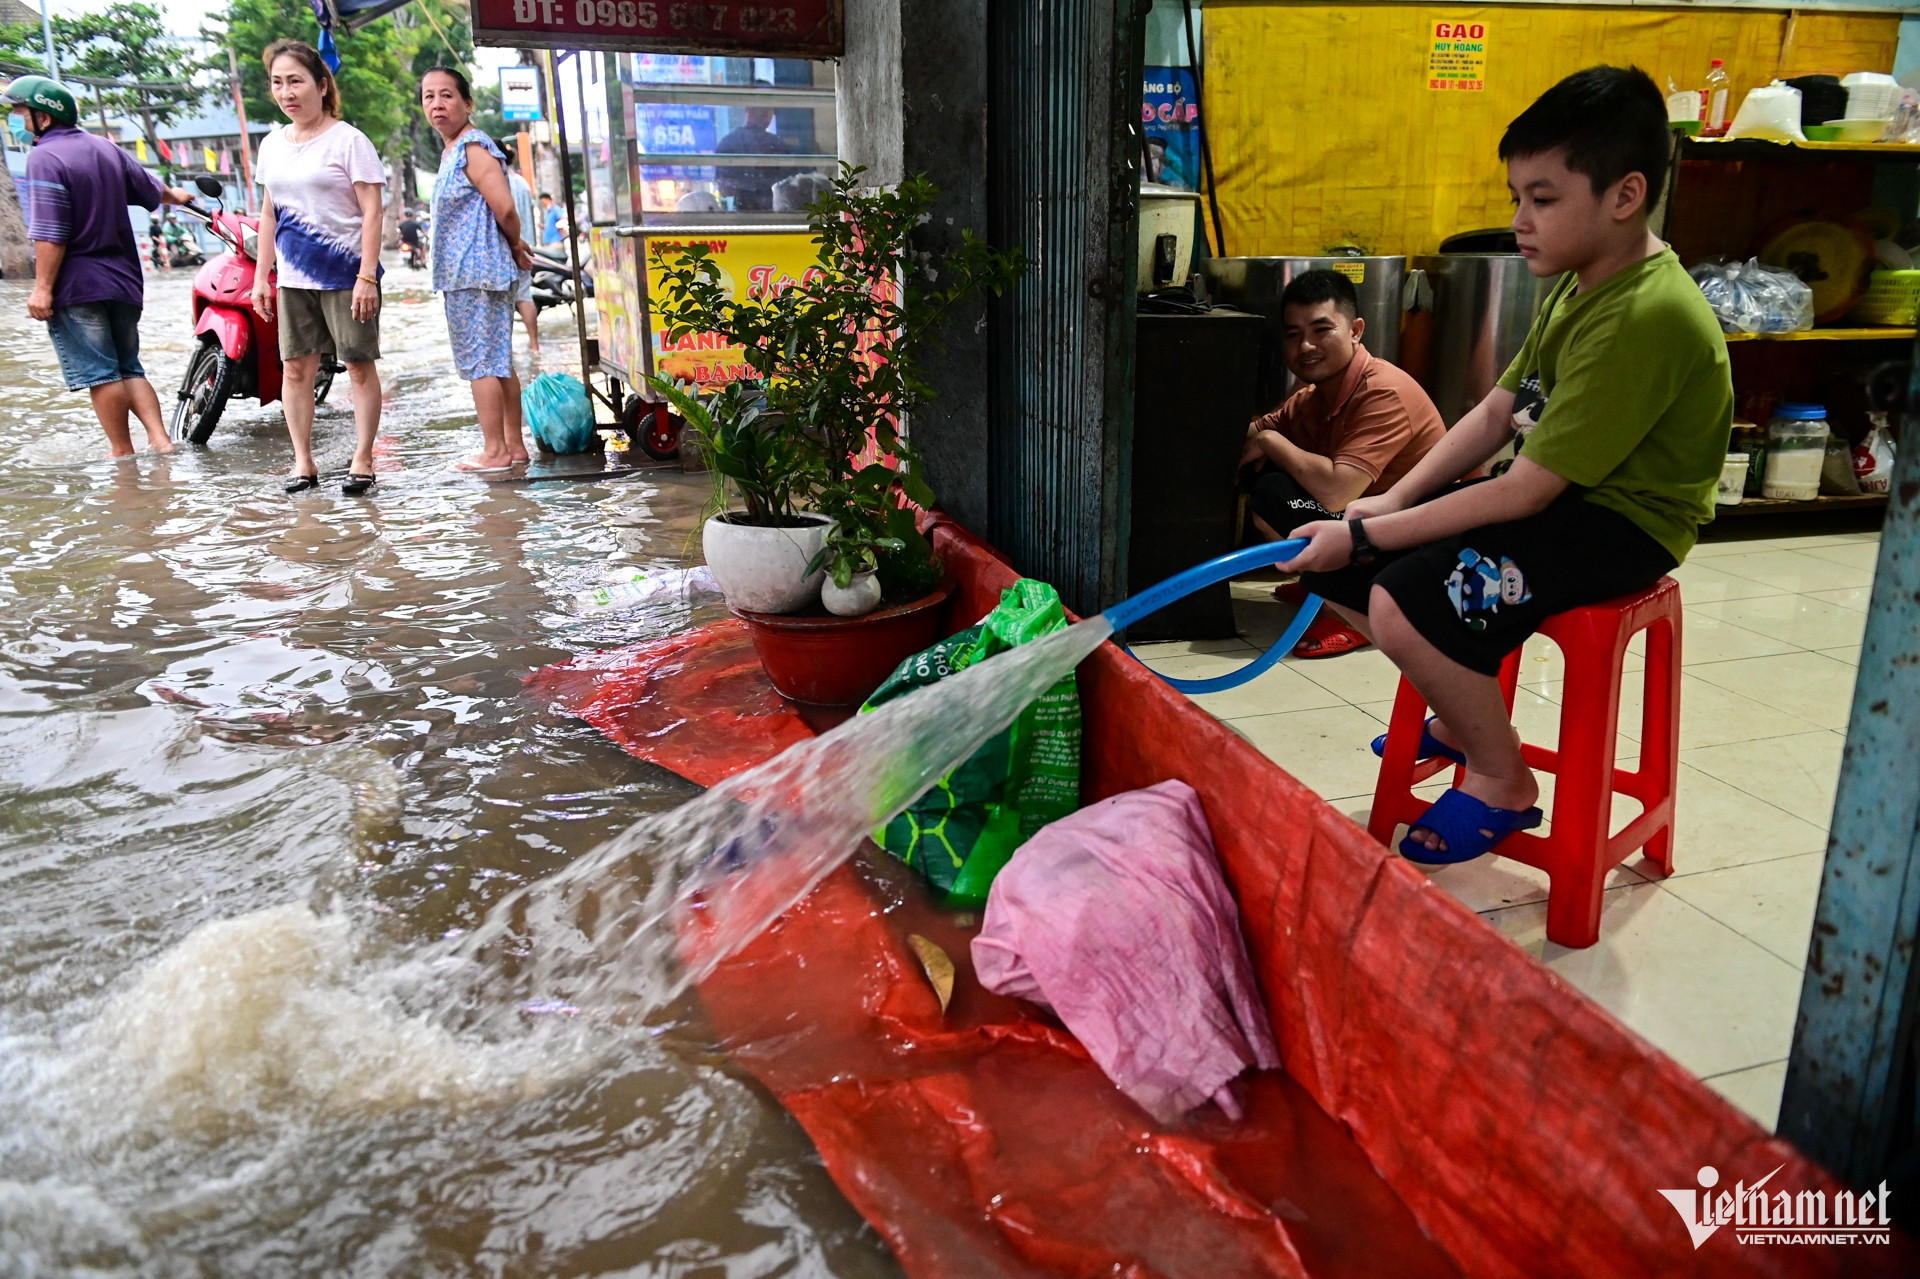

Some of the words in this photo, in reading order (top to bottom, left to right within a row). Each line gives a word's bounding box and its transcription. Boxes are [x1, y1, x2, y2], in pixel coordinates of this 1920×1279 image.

[513, 0, 564, 24] ĐT:
[576, 0, 658, 28] 0985
[1436, 23, 1484, 42] GẠO
[1435, 43, 1451, 51] HUY
[1454, 42, 1483, 52] HOÀNG
[34, 93, 65, 112] Grab
[653, 124, 696, 146] 65A
